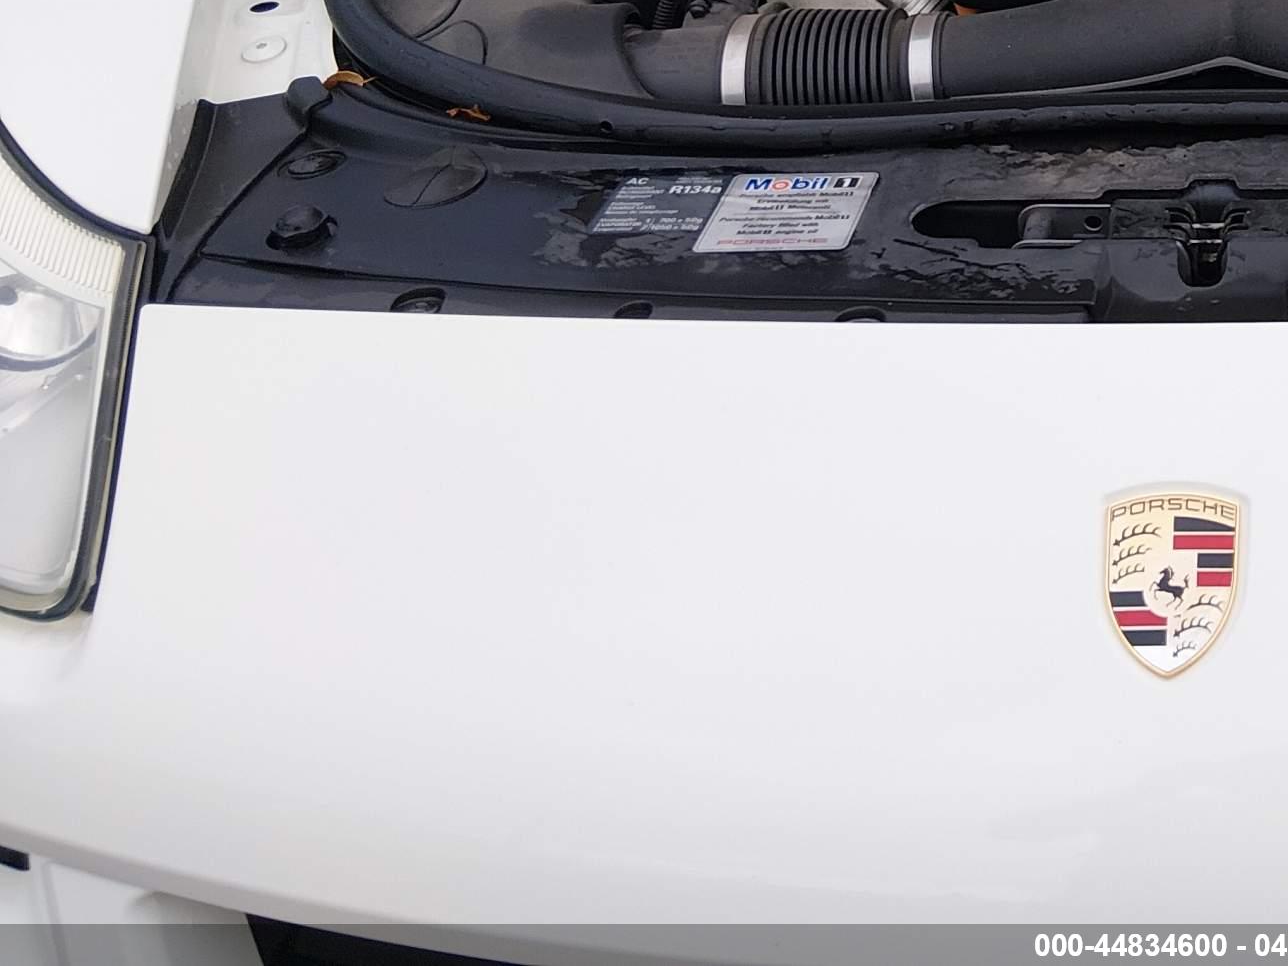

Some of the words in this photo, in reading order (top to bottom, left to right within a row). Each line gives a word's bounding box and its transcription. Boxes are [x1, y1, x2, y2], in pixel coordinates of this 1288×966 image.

[626, 177, 650, 185] AC
[745, 177, 829, 191] Mobil
[669, 185, 723, 194] R134a
[717, 237, 828, 246] PORSCHE
[1110, 498, 1235, 522] PORSCHE
